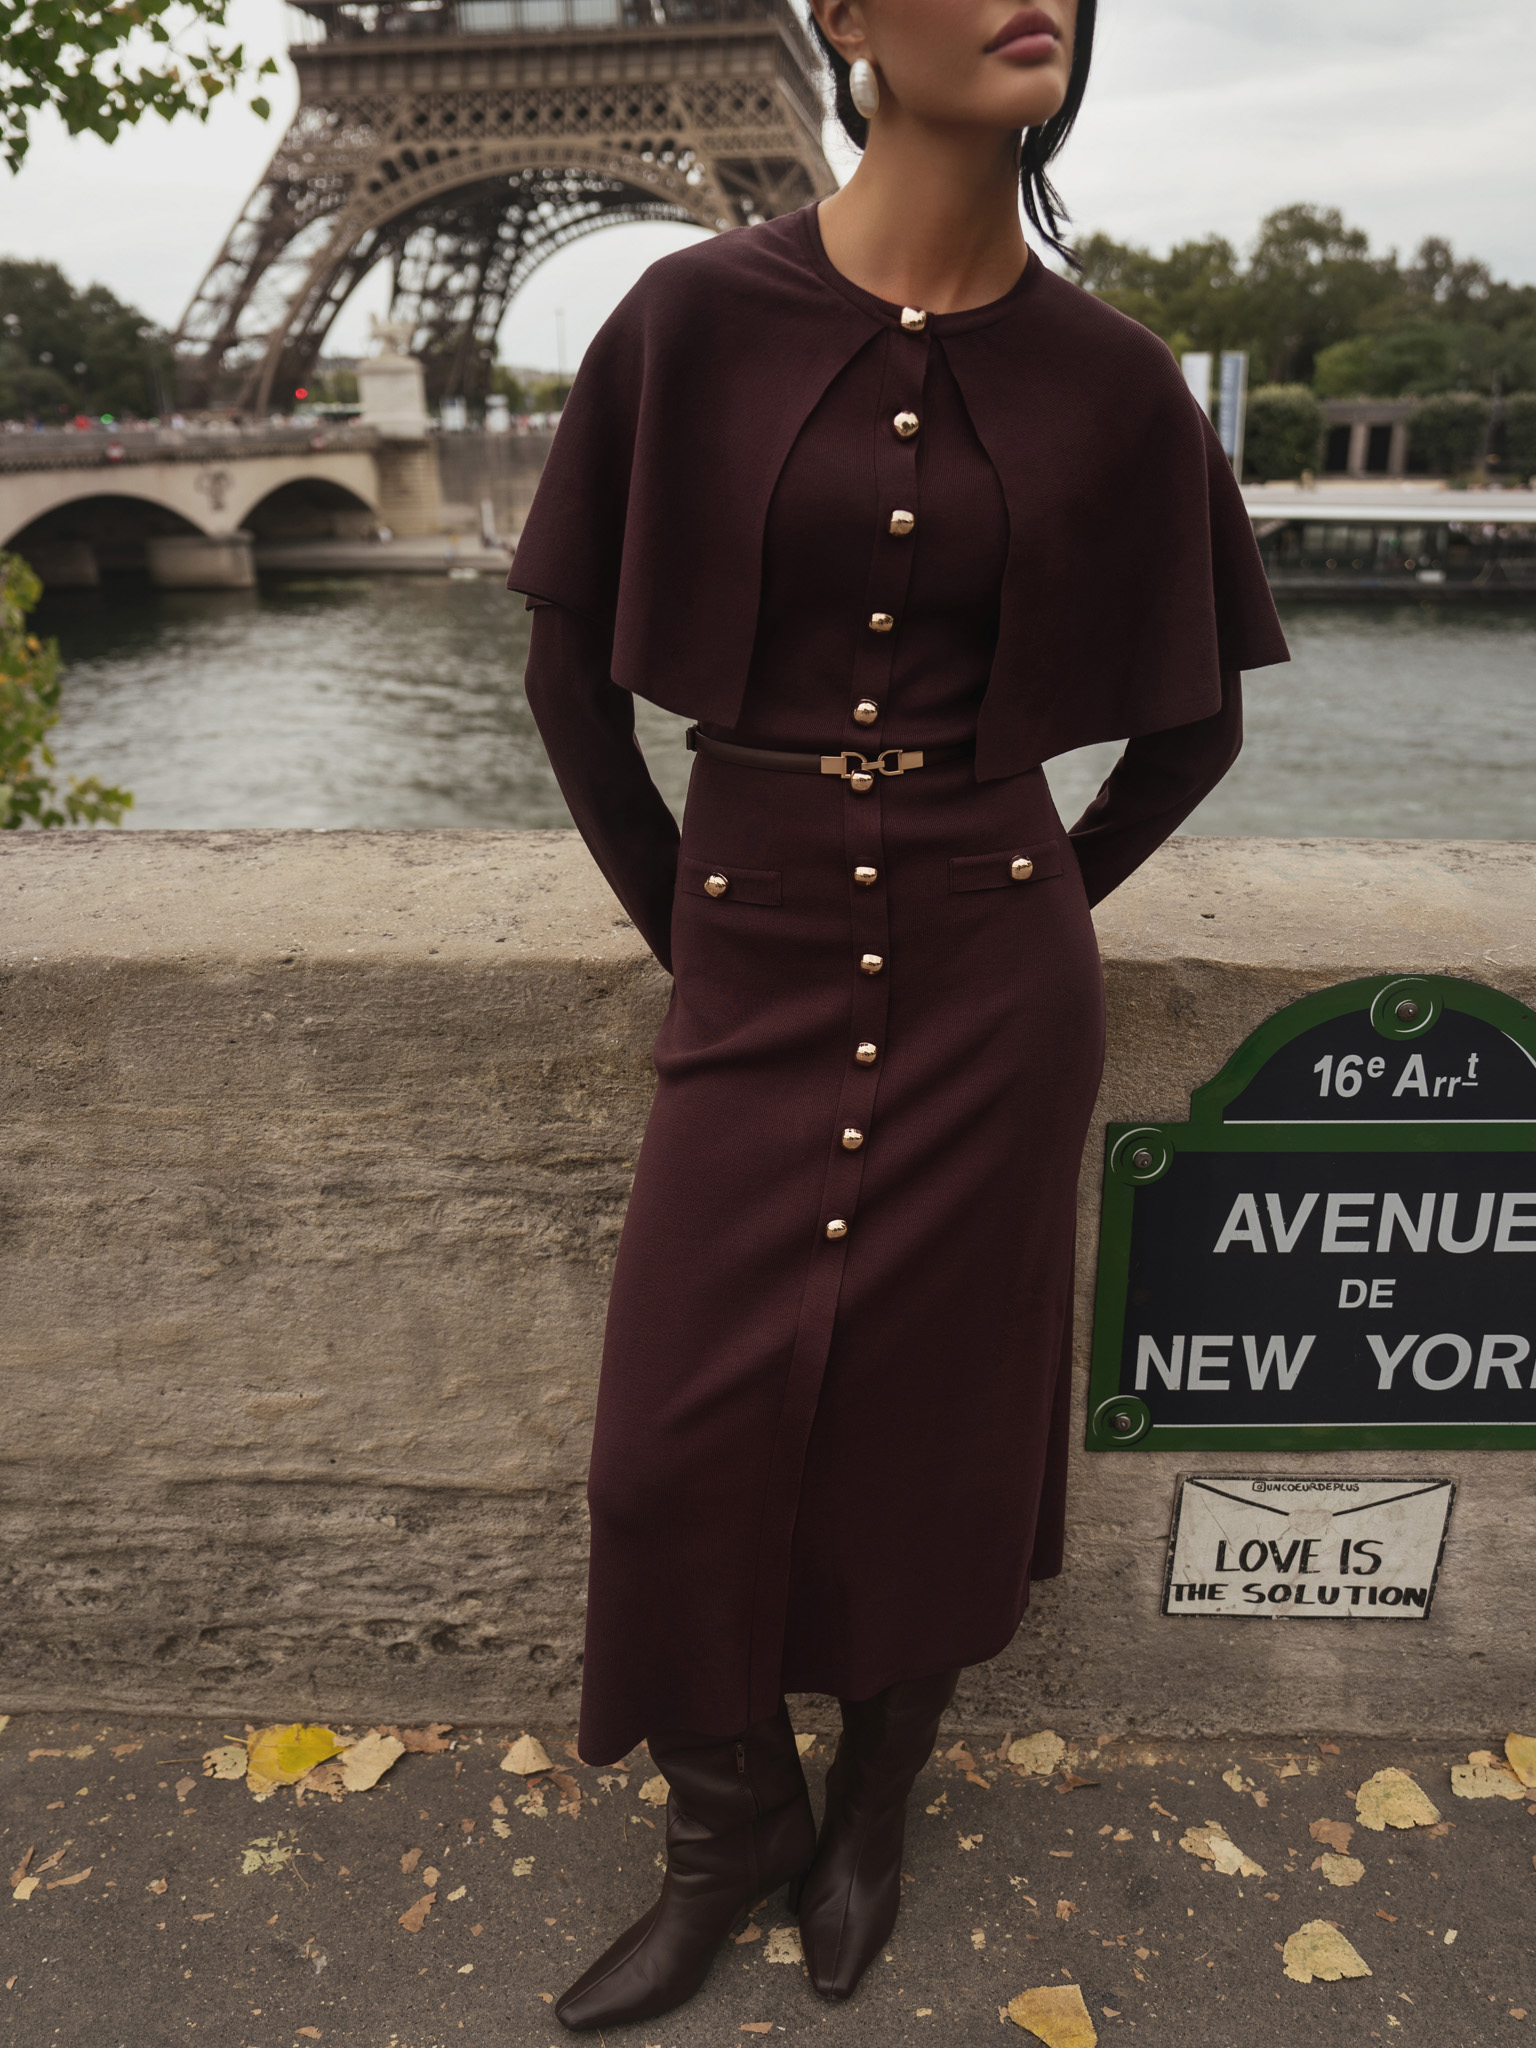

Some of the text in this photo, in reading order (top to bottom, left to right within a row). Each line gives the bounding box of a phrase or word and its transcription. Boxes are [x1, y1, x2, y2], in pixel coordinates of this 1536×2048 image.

[1213, 1192, 1536, 1254] AVENUE
[1338, 1279, 1396, 1309] DE
[1134, 1333, 1536, 1391] NEW YOR
[1215, 1538, 1384, 1575] LOVE IS
[1171, 1583, 1428, 1608] THE SOLUTION
